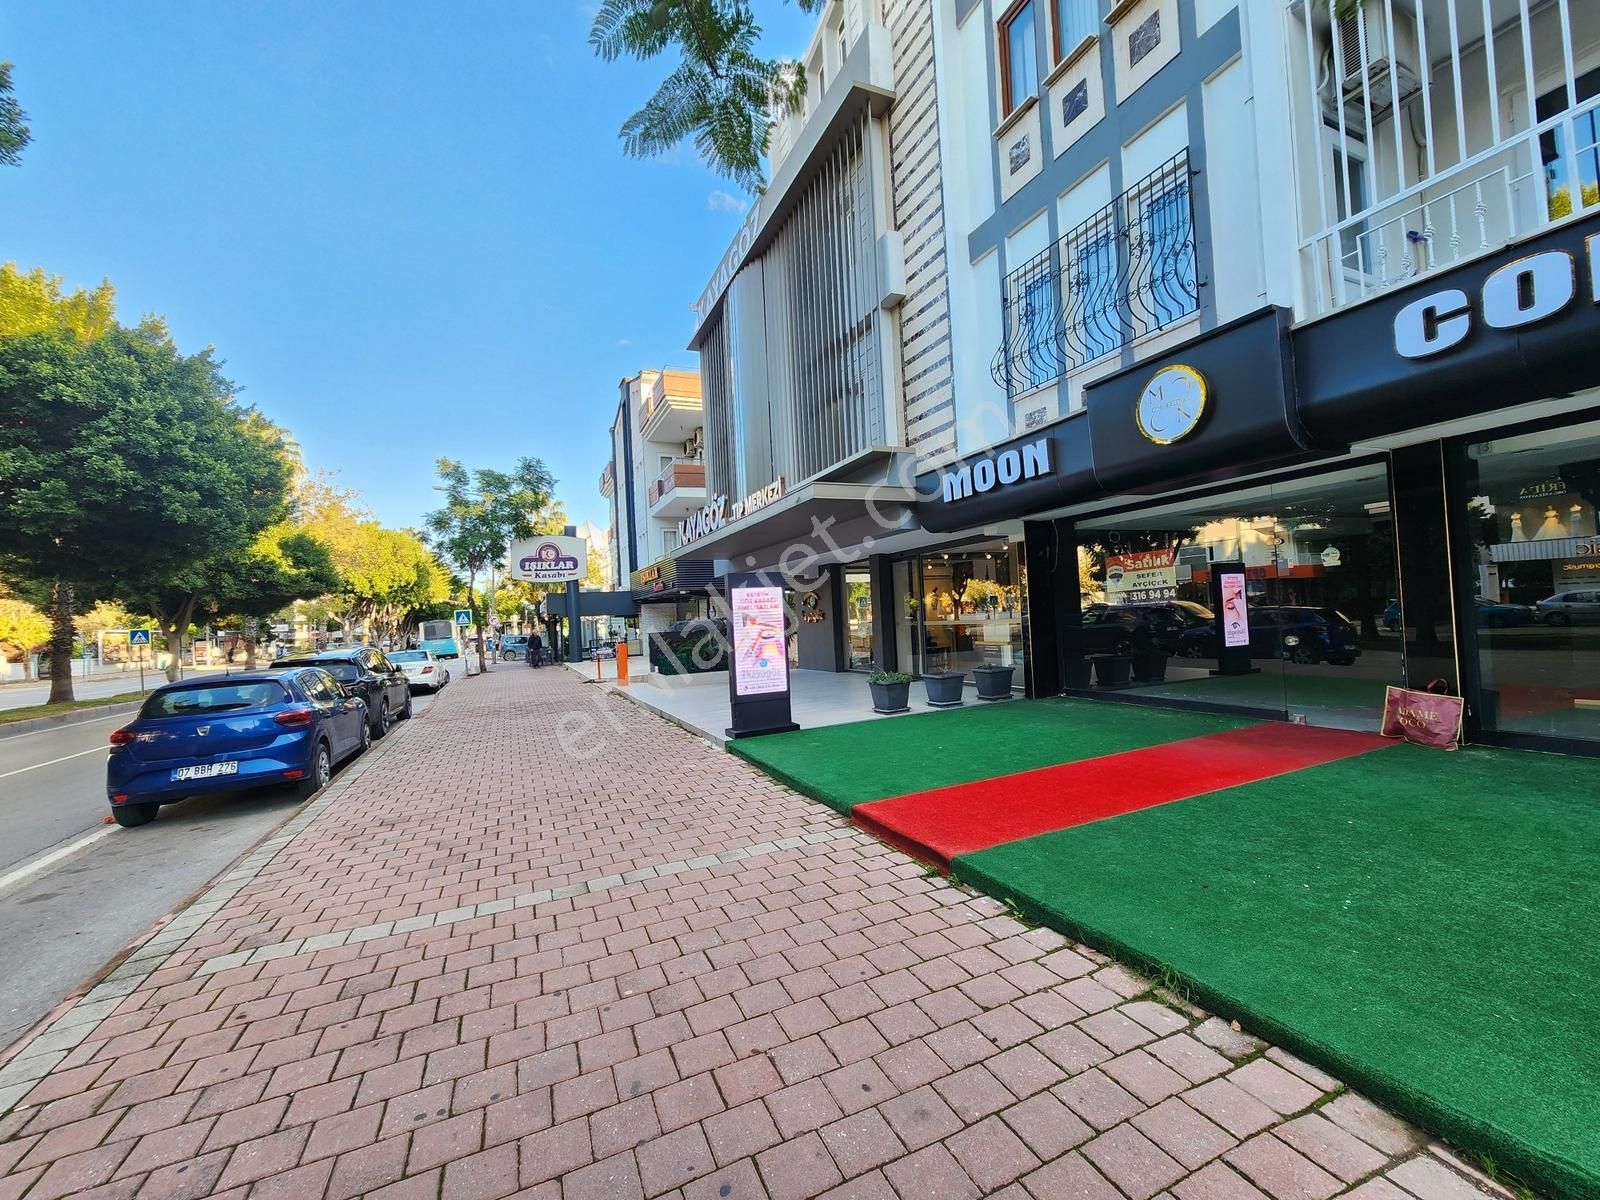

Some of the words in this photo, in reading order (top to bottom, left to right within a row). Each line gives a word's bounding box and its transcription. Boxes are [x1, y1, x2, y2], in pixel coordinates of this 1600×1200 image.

[943, 438, 1050, 504] MOON
[679, 492, 726, 546] KAYAGÖZ
[1132, 591, 1147, 600] 316
[1148, 589, 1161, 599] 94
[1163, 588, 1176, 598] 94
[178, 767, 191, 777] 07
[218, 762, 236, 772] 276
